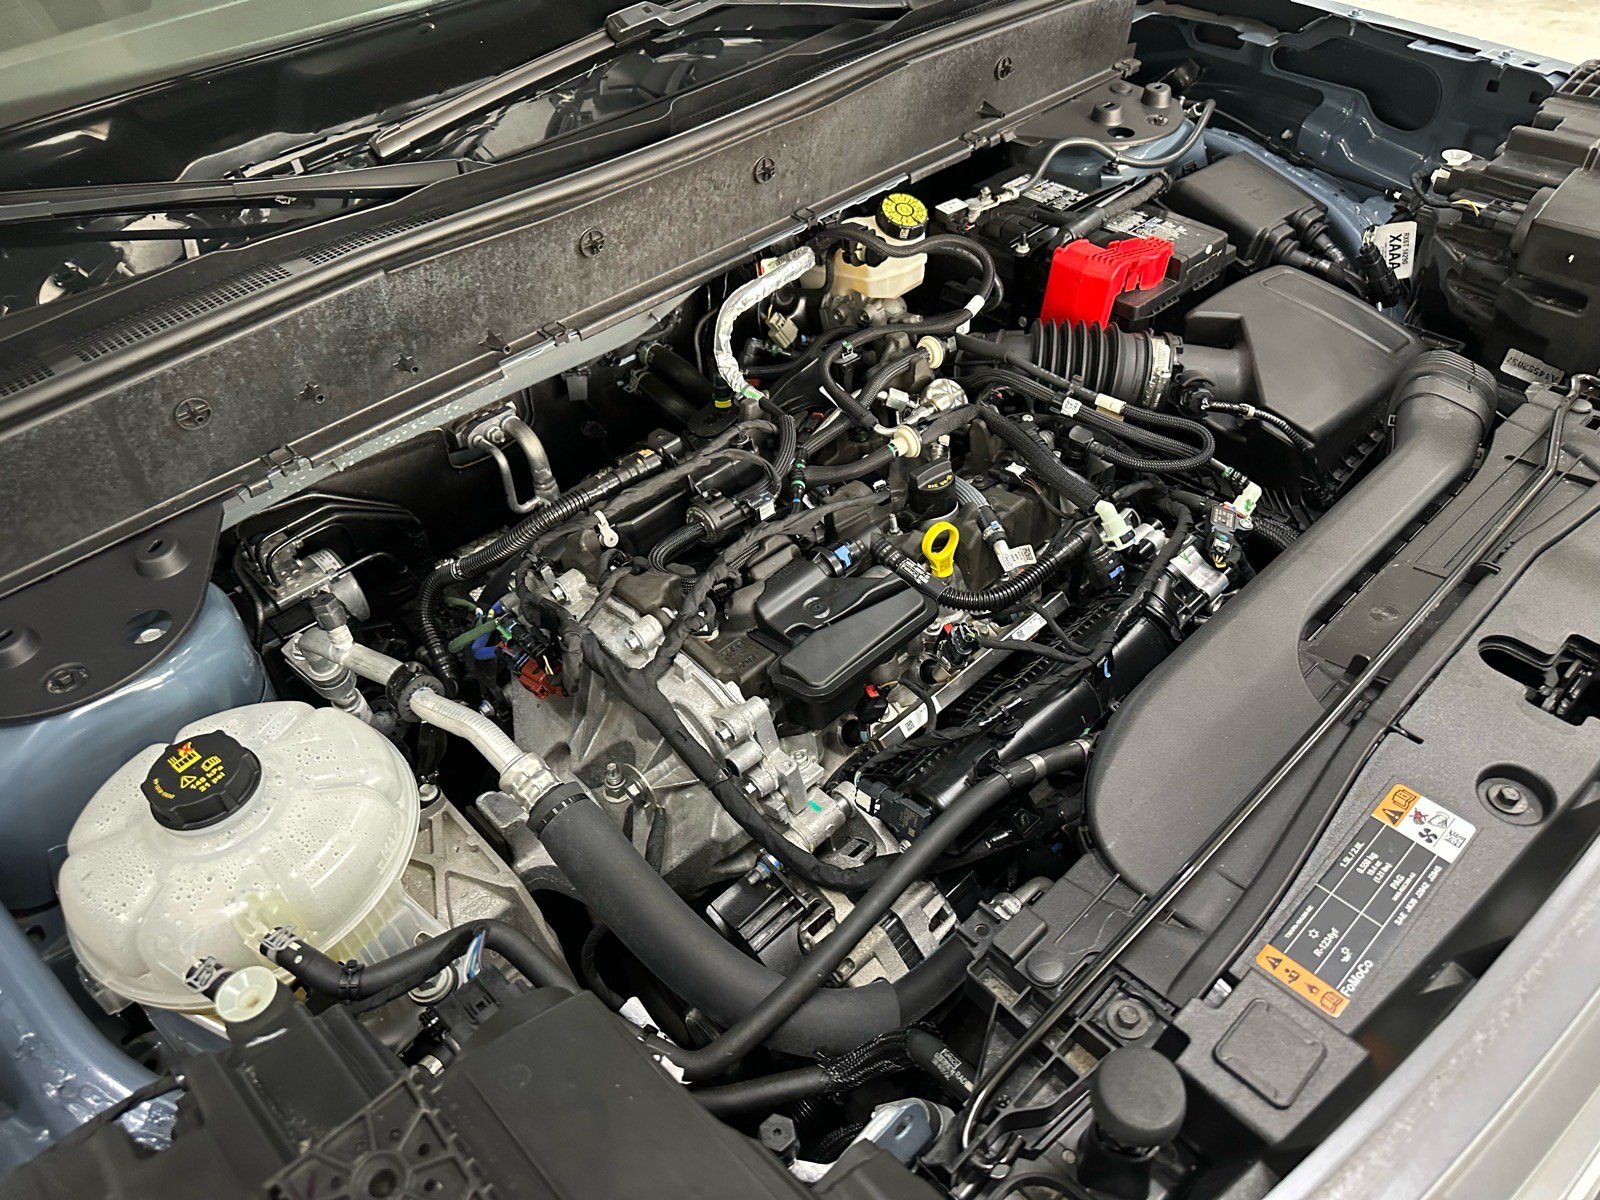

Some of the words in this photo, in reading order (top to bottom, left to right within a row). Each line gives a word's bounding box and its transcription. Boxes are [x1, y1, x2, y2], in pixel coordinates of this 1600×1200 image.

[1389, 234, 1401, 269] XAAA
[190, 776, 206, 790] 145
[206, 765, 224, 778] kPa
[198, 782, 211, 793] 21
[211, 771, 225, 784] psi
[1389, 874, 1405, 890] PAG
[1393, 912, 1407, 926] SAE
[1313, 927, 1340, 957] R-1234yf
[1340, 960, 1374, 996] FoMoCo
